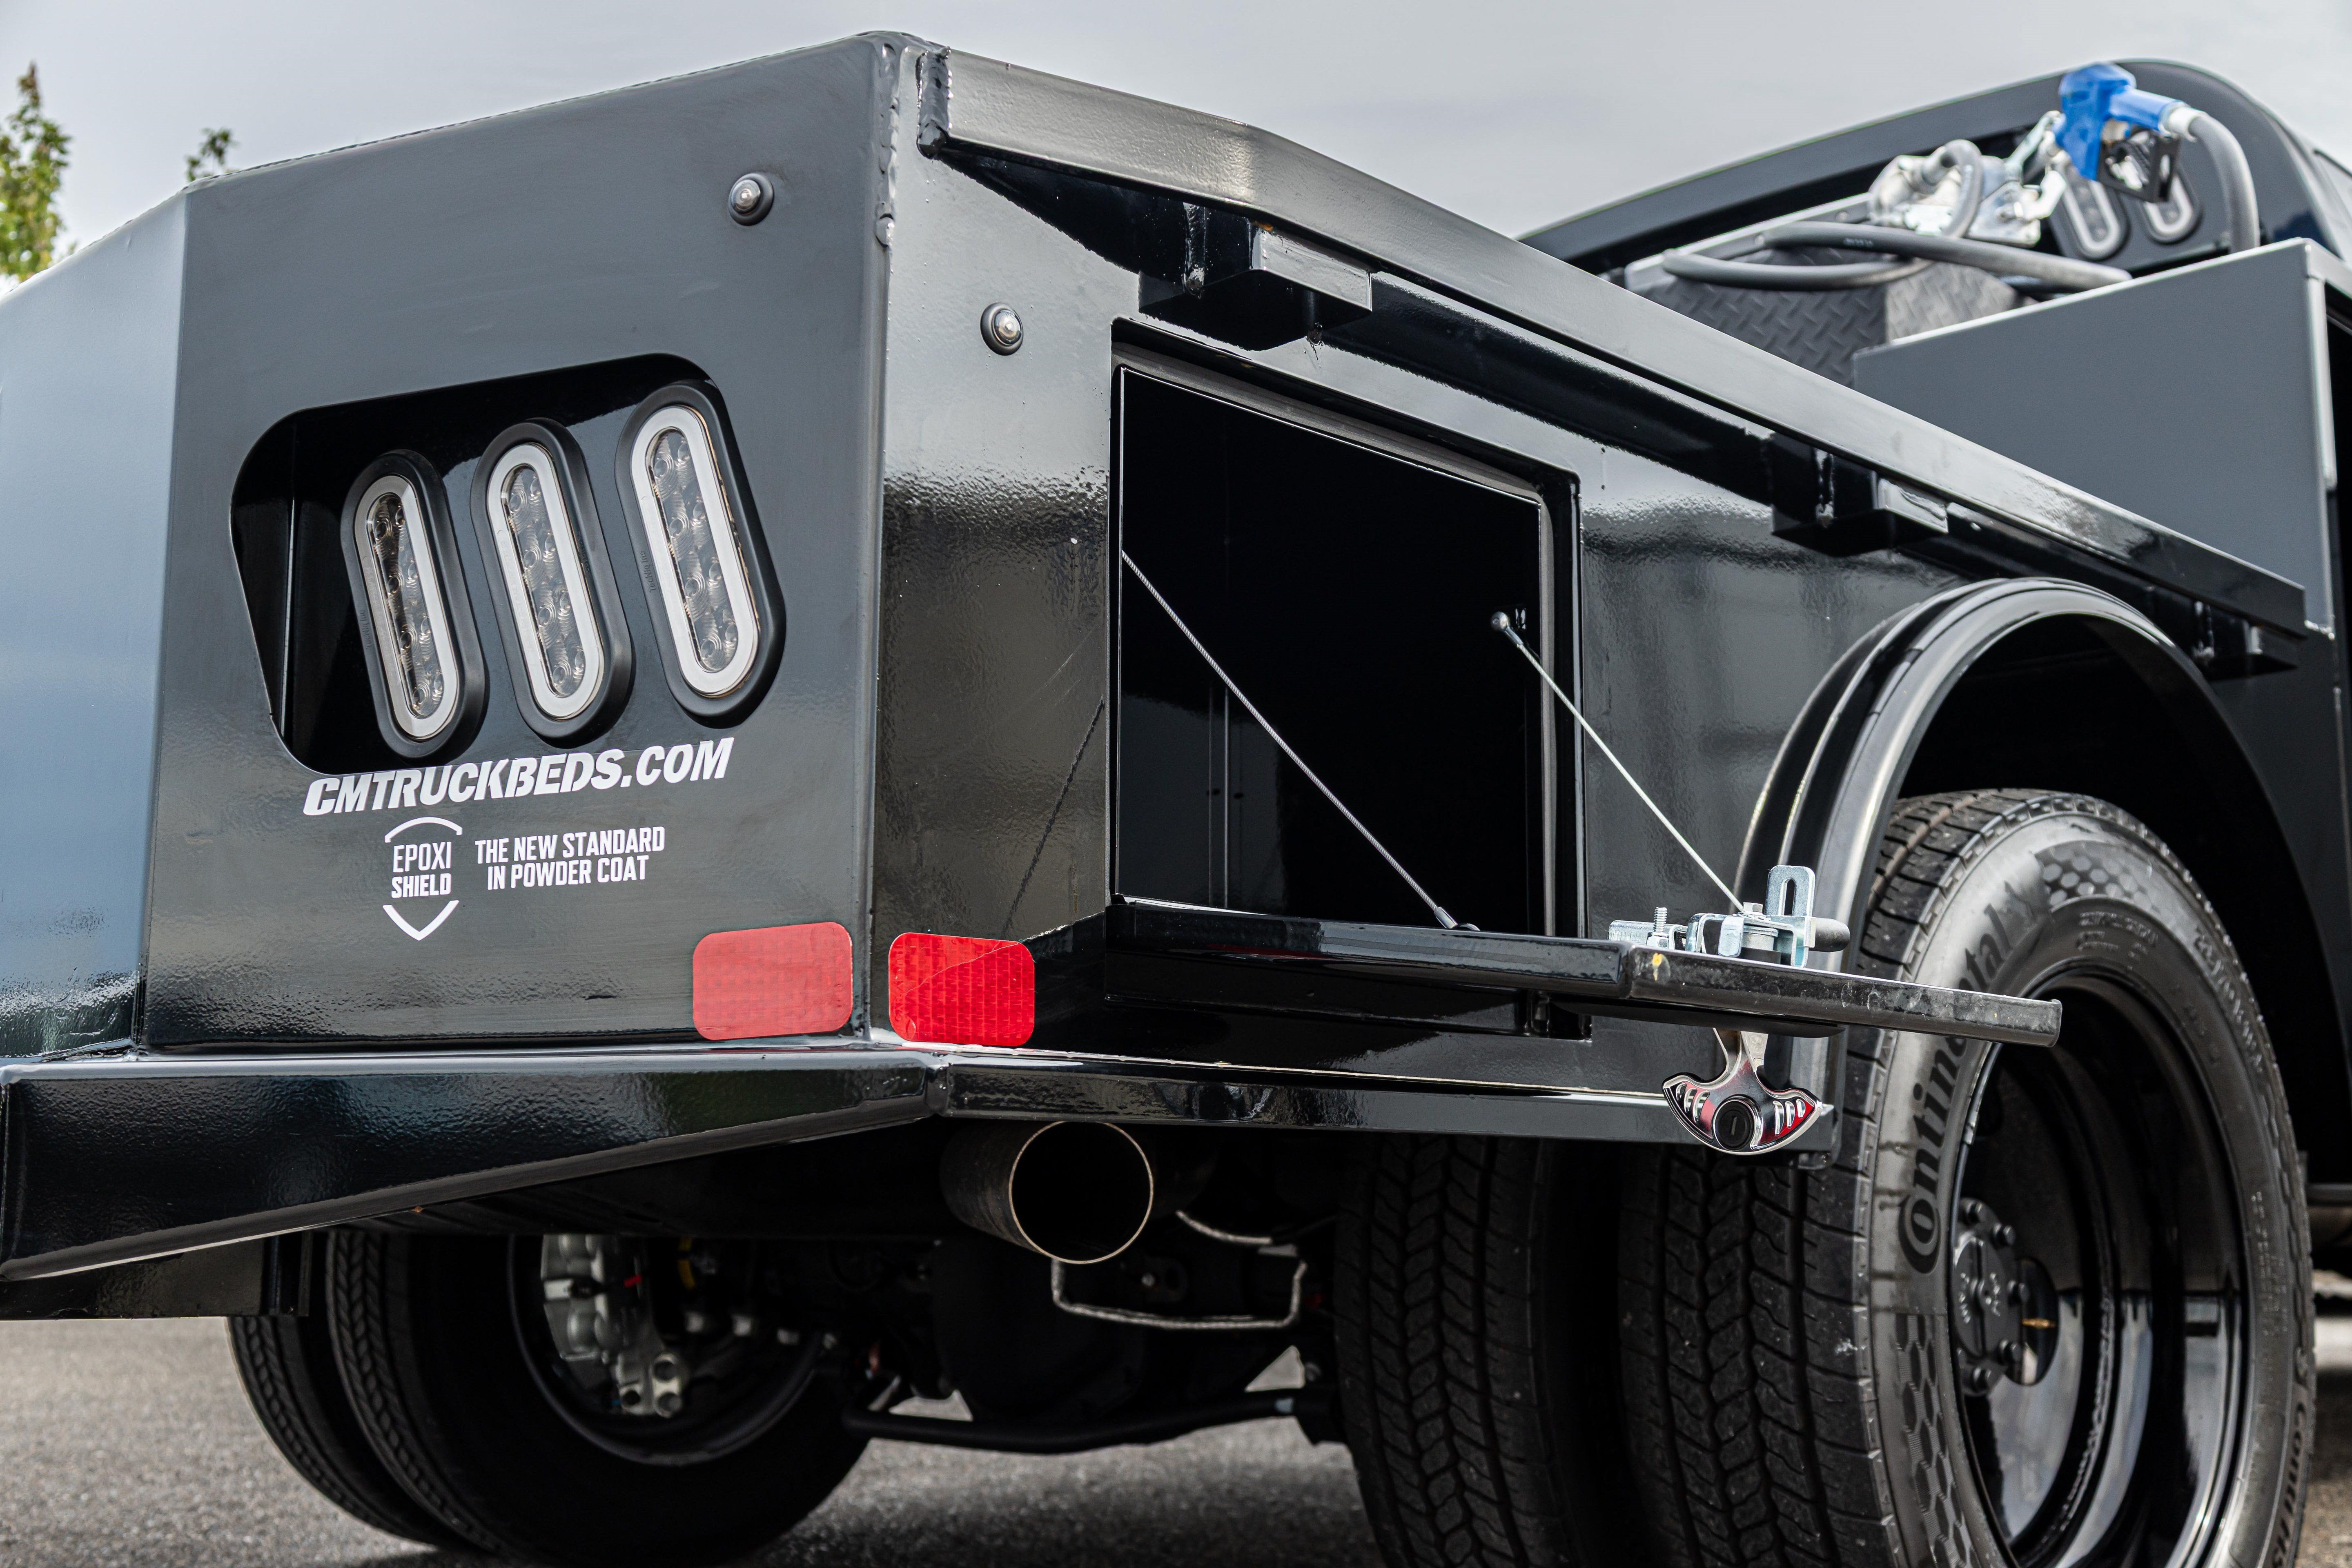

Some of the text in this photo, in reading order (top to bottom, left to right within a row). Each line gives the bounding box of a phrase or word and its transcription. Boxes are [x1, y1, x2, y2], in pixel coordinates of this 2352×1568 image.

[303, 737, 735, 816] CMTRUCKBEDS.COM
[392, 841, 452, 873] EPOXI
[474, 826, 666, 864] THE NEW STANDARD
[391, 872, 452, 899] SHIELD
[487, 854, 650, 891] IN POWDER COAT
